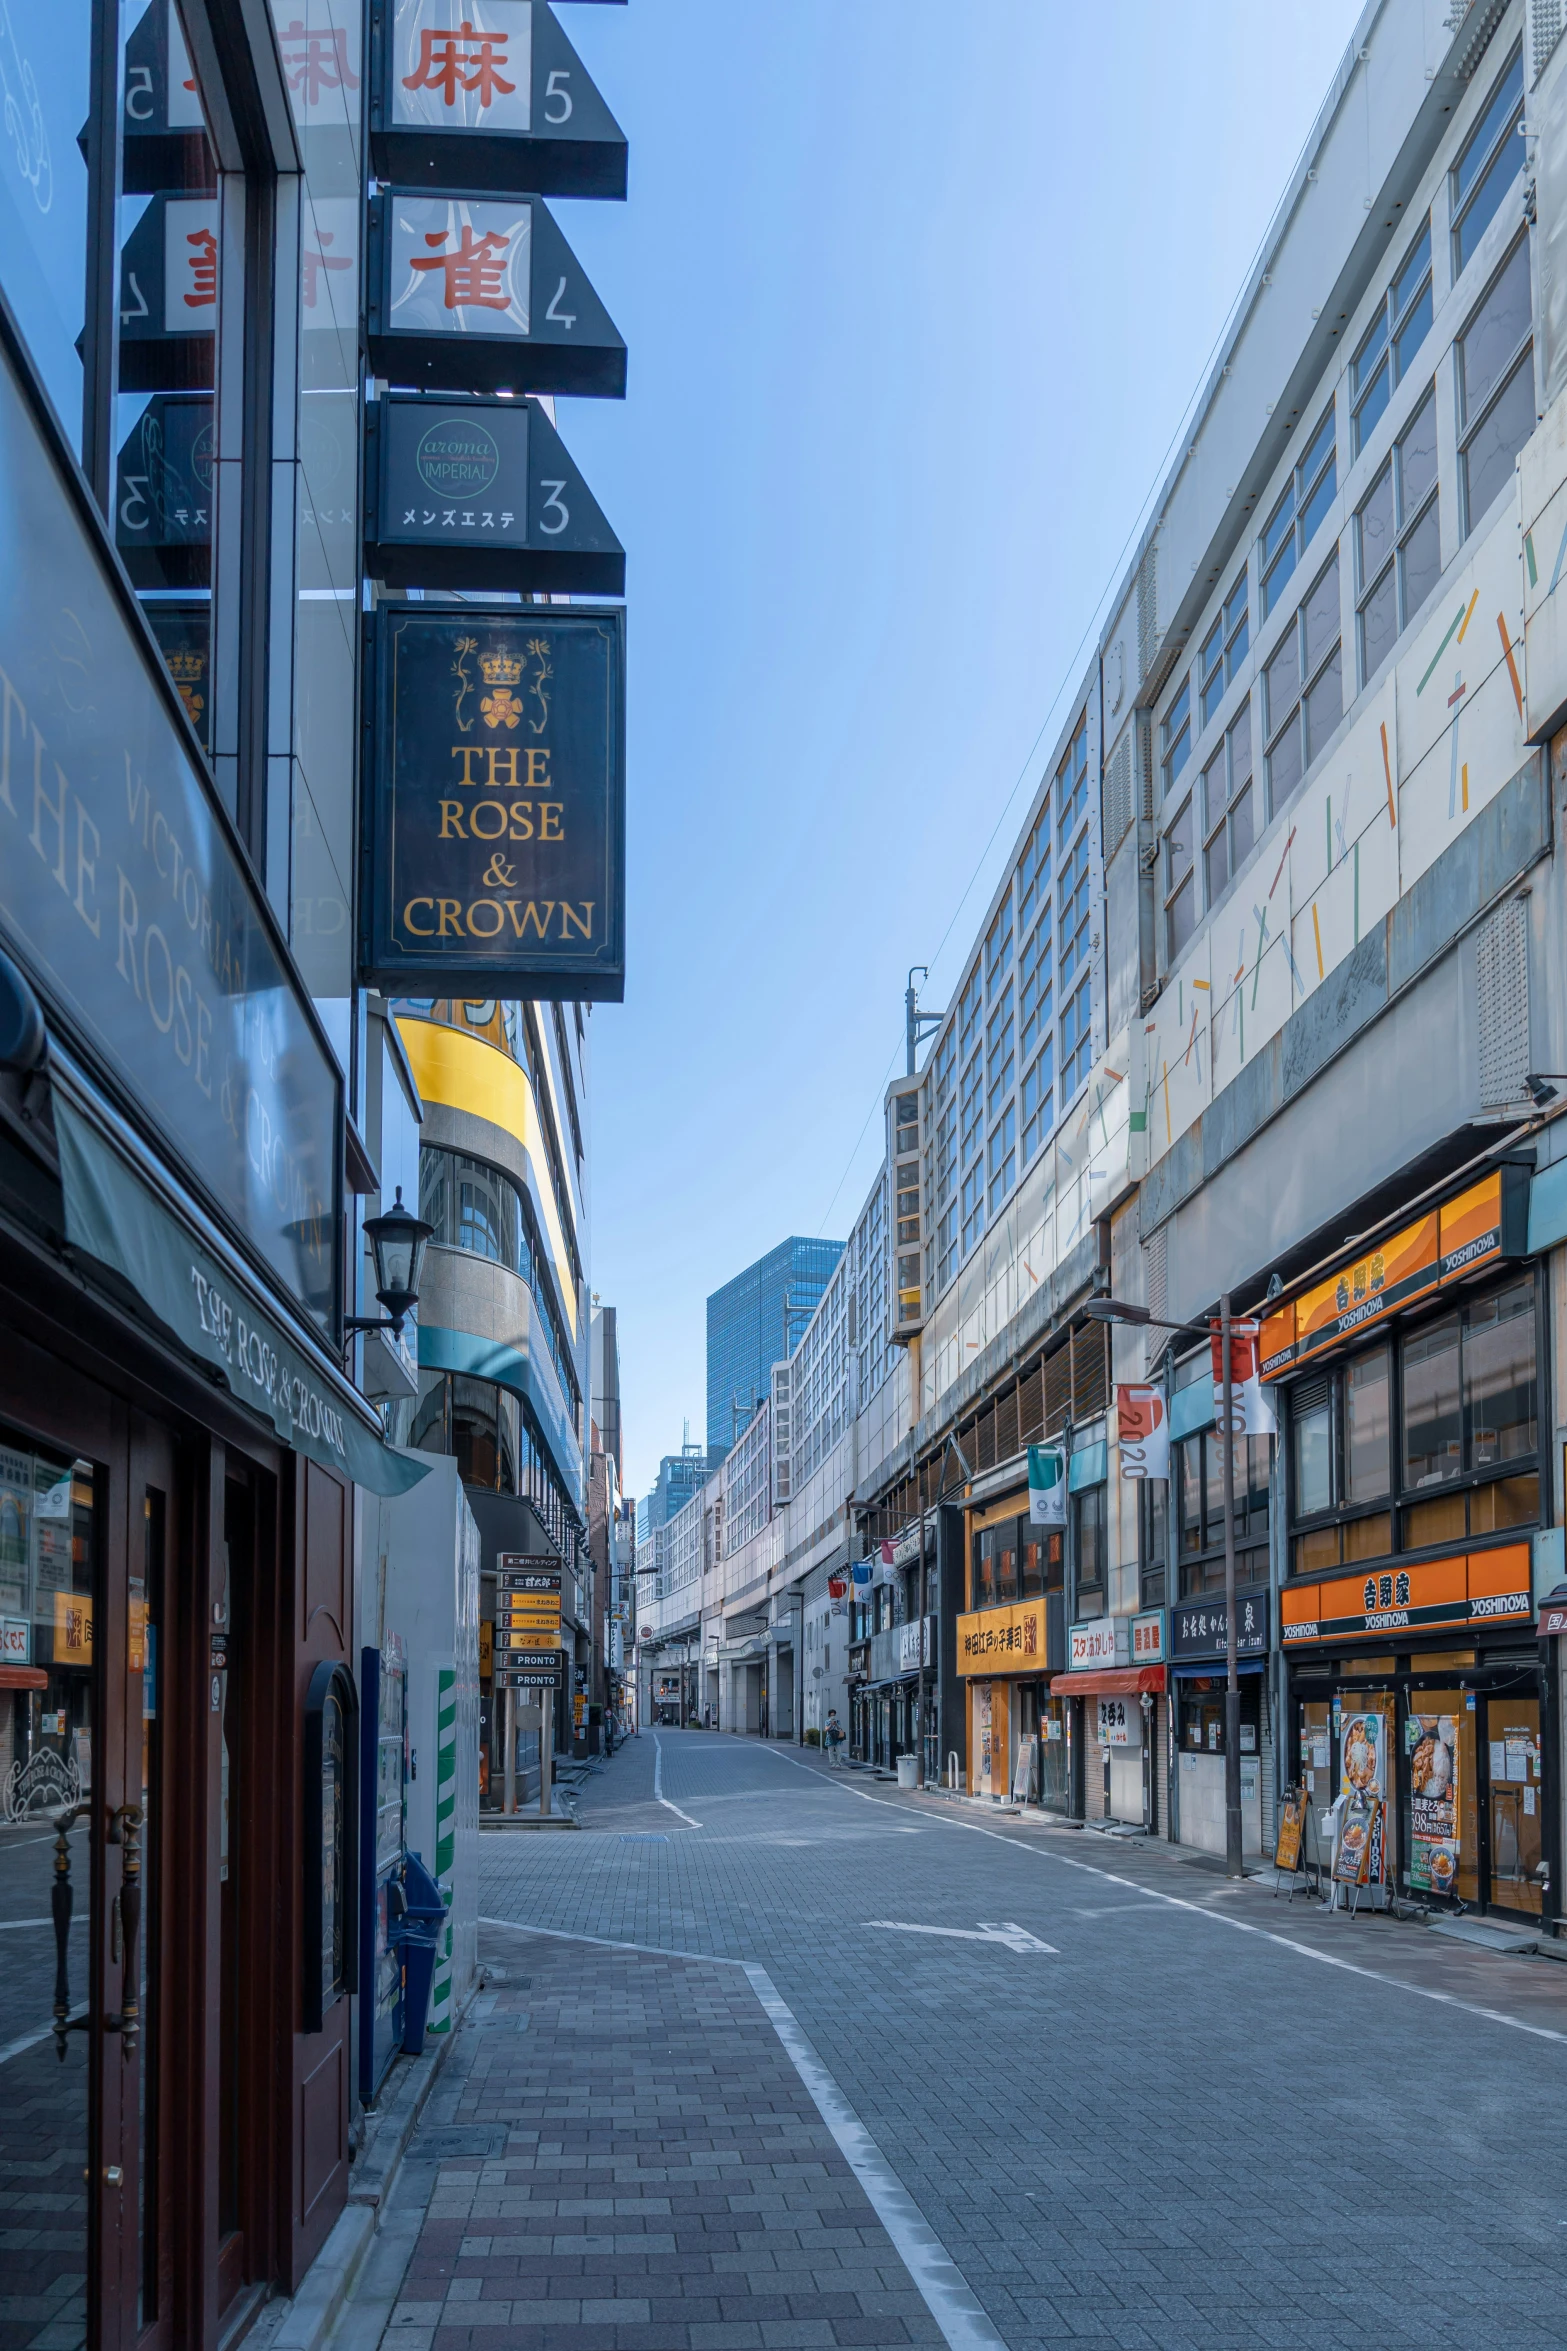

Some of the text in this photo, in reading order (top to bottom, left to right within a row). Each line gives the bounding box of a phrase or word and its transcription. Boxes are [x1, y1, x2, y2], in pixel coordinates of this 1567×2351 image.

[402, 21, 517, 108] 麻
[544, 71, 574, 124] 5
[410, 224, 513, 311] 雀
[546, 276, 577, 330] 4
[424, 441, 490, 455] aroma
[425, 462, 489, 481] IMPERIAL
[402, 508, 515, 529] メンズエステ
[539, 479, 570, 535] 3
[451, 746, 551, 787] THE
[438, 801, 565, 841] ROSE
[124, 748, 245, 997] VICTORIAN
[482, 852, 518, 888] &
[403, 897, 595, 939] CROWN
[0, 662, 101, 940] THE
[116, 865, 212, 1100] ROSE
[245, 1087, 324, 1267] CROWN
[1445, 1232, 1496, 1272] YOSHINOYA
[1338, 1295, 1384, 1333] YOSHINOYA
[191, 1266, 346, 1458] THE ROSE & CROWN
[1261, 1348, 1293, 1375] YOSHINOYA
[1118, 1411, 1148, 1480] 2020
[1244, 1602, 1255, 1633] 泉
[1365, 1611, 1409, 1629] YOSHINOYA
[1471, 1593, 1530, 1617] YOSHINOYA
[1073, 1637, 1089, 1659] スタ
[1089, 1631, 1114, 1658] あかしや
[1134, 1625, 1160, 1652] 居酒屋
[1216, 1633, 1263, 1650] Kitc bar izumi
[1283, 1622, 1318, 1639] YOSHINOYA
[518, 1656, 555, 1665] PRONTO
[517, 1676, 555, 1685] PRONTO
